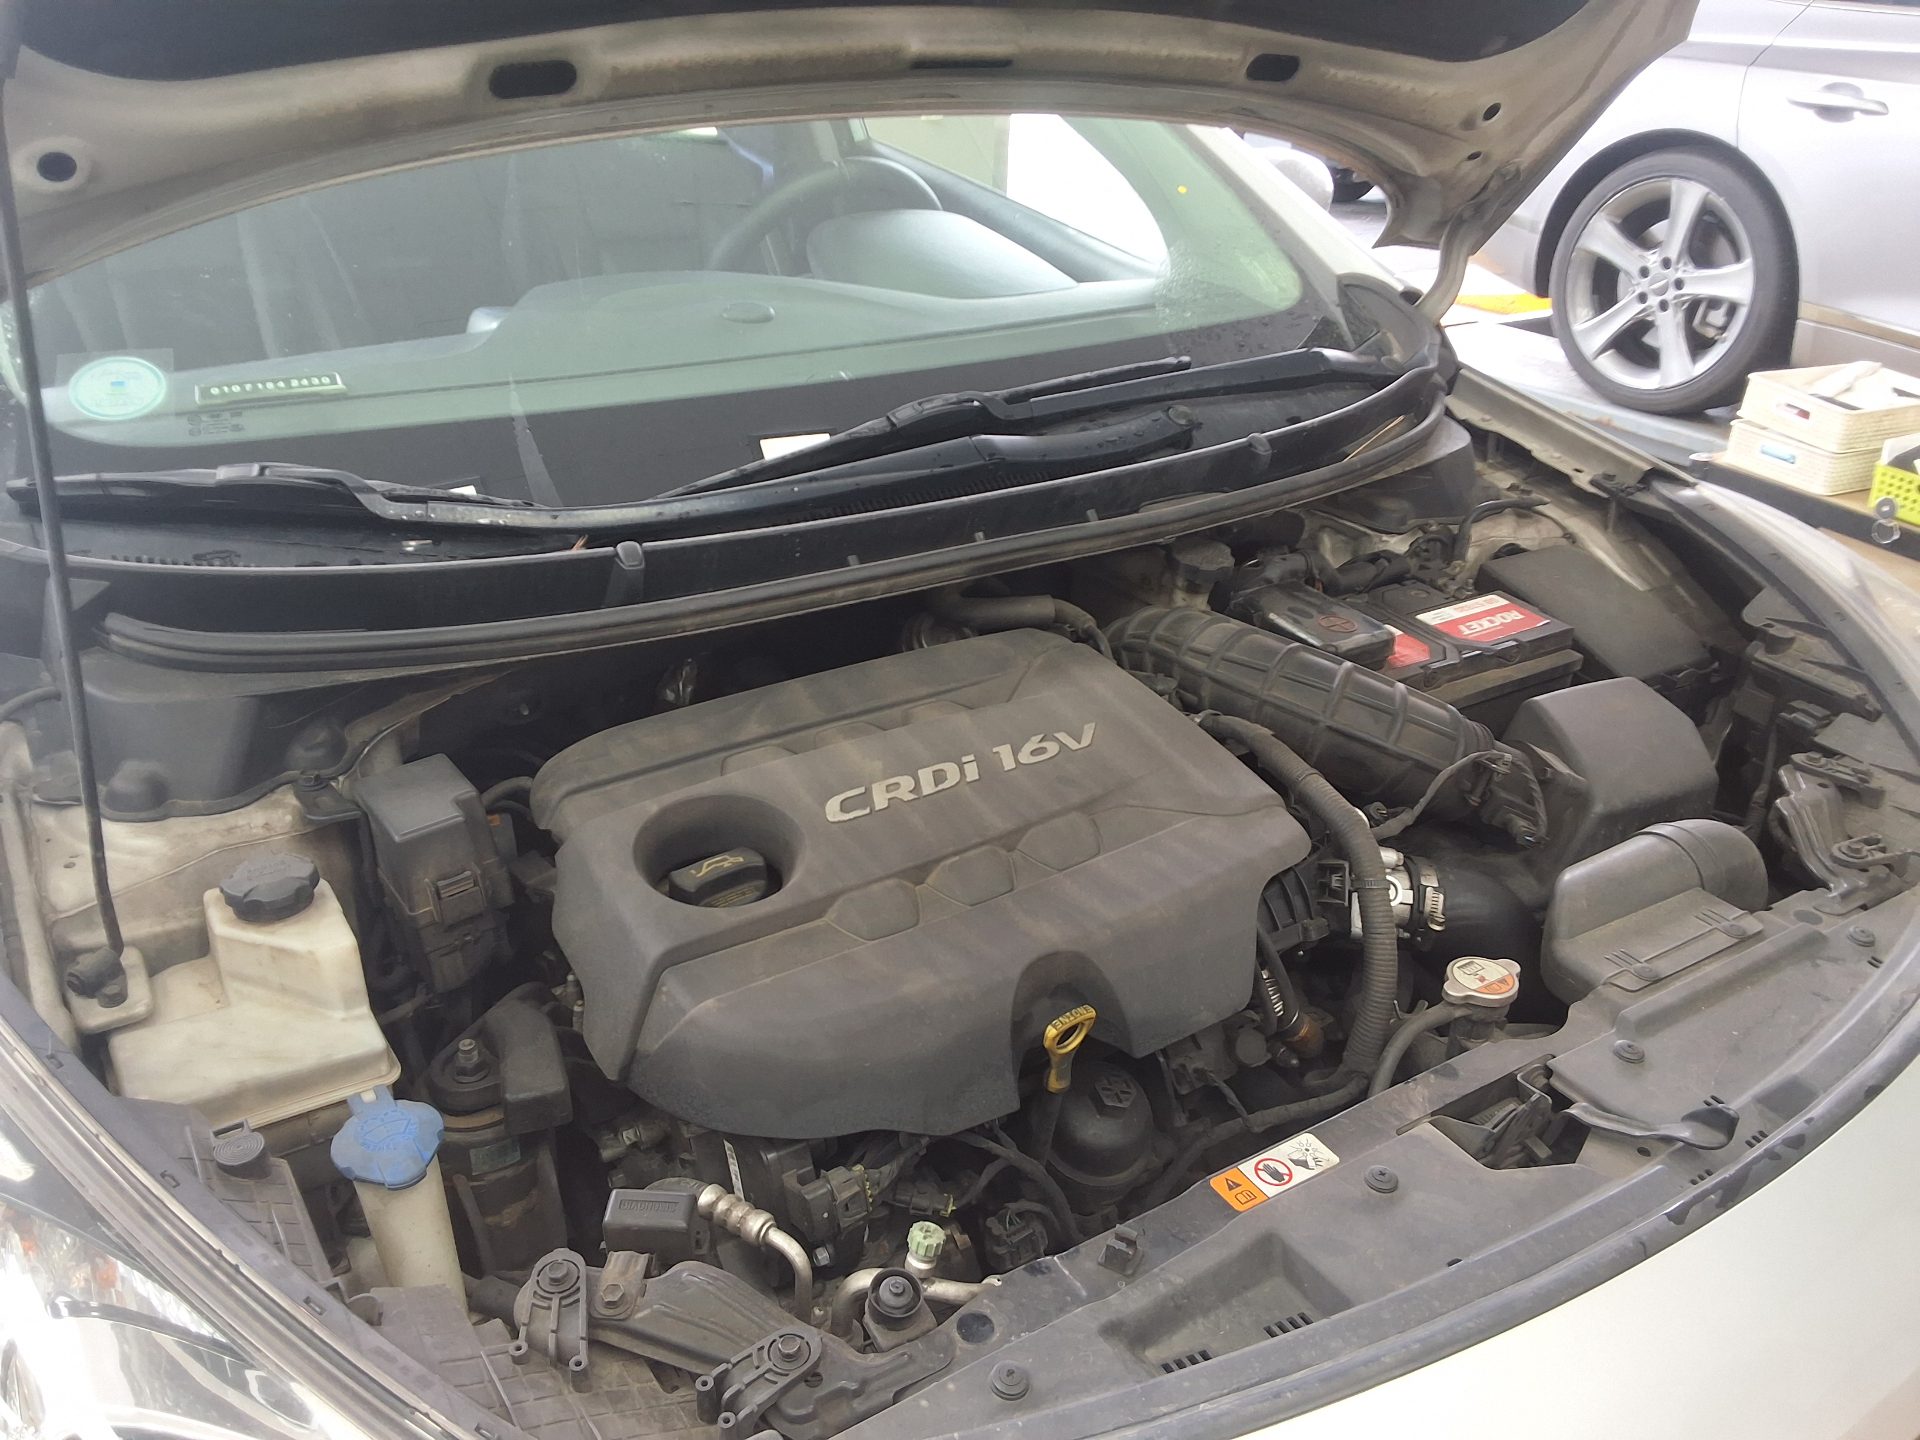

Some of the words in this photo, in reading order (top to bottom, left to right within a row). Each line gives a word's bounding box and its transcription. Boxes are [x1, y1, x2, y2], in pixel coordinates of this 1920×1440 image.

[1458, 609, 1526, 635] ROCKET
[824, 753, 981, 823] CRDi
[992, 722, 1096, 772] 16V
